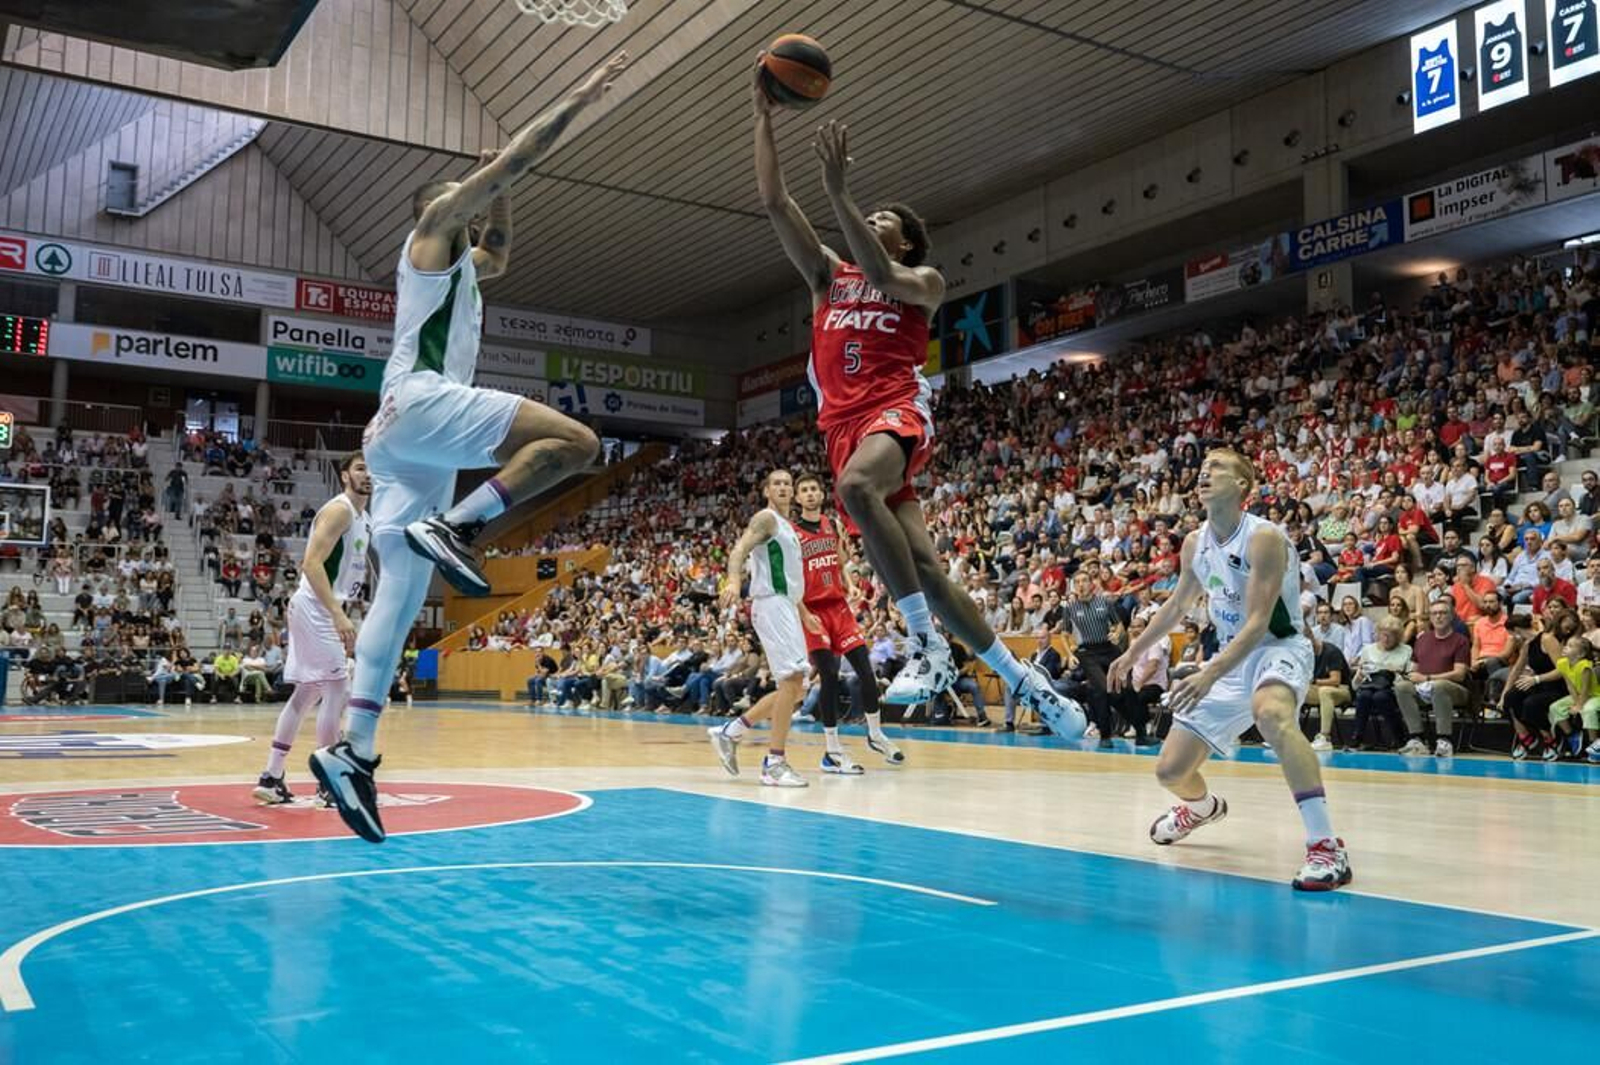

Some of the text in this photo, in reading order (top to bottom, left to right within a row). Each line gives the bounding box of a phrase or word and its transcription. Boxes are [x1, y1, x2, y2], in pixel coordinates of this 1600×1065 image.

[1563, 12, 1585, 45] 7
[1490, 42, 1512, 70] 9
[1427, 68, 1443, 95] 7
[1437, 168, 1509, 199] La DIGITAL
[1438, 189, 1497, 220] impser
[1298, 206, 1387, 244] CALSINA
[121, 259, 176, 290] LLEAL
[184, 267, 244, 299] TULSÀ
[823, 309, 901, 334] FIATC
[115, 332, 218, 363] parlem
[273, 321, 366, 354] Panella
[275, 354, 366, 384] wifiboo
[844, 341, 862, 375] 5
[561, 356, 693, 394] L'ESPORTIU
